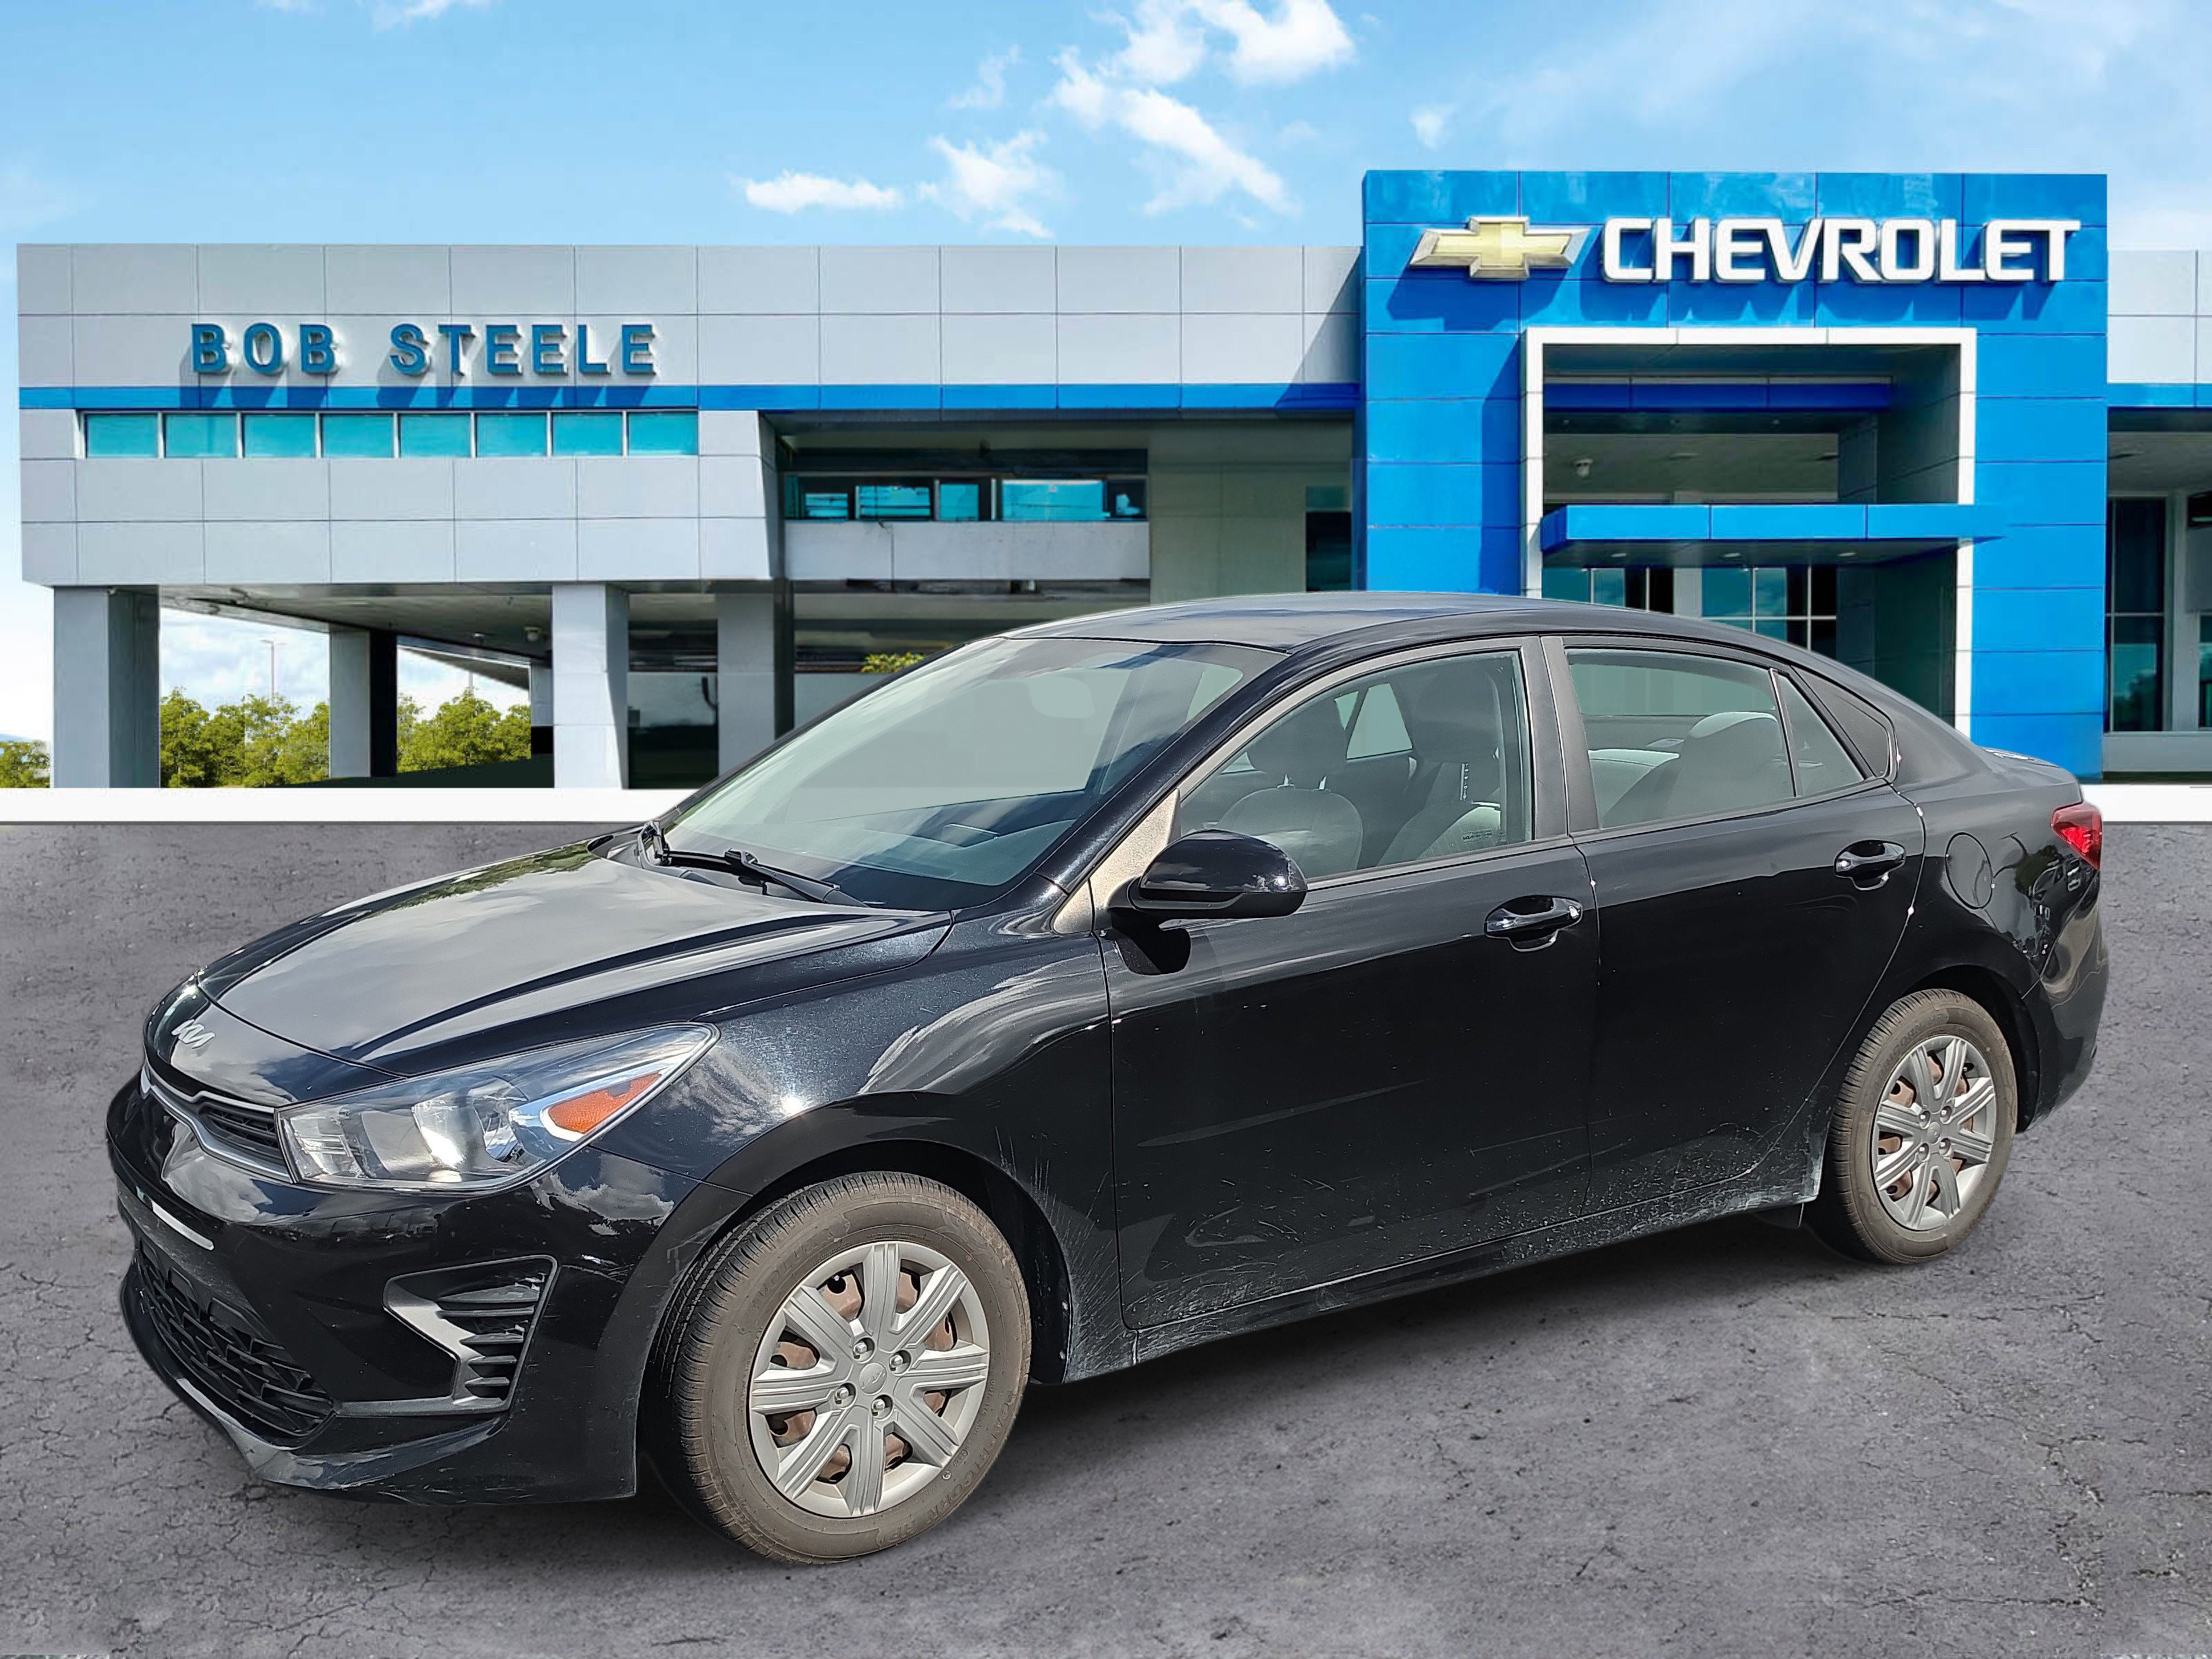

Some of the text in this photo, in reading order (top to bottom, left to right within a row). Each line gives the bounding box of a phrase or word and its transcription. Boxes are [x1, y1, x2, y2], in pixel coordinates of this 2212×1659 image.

[1602, 217, 2082, 284] CHEVROLET
[192, 323, 657, 376] BOB STEELE
